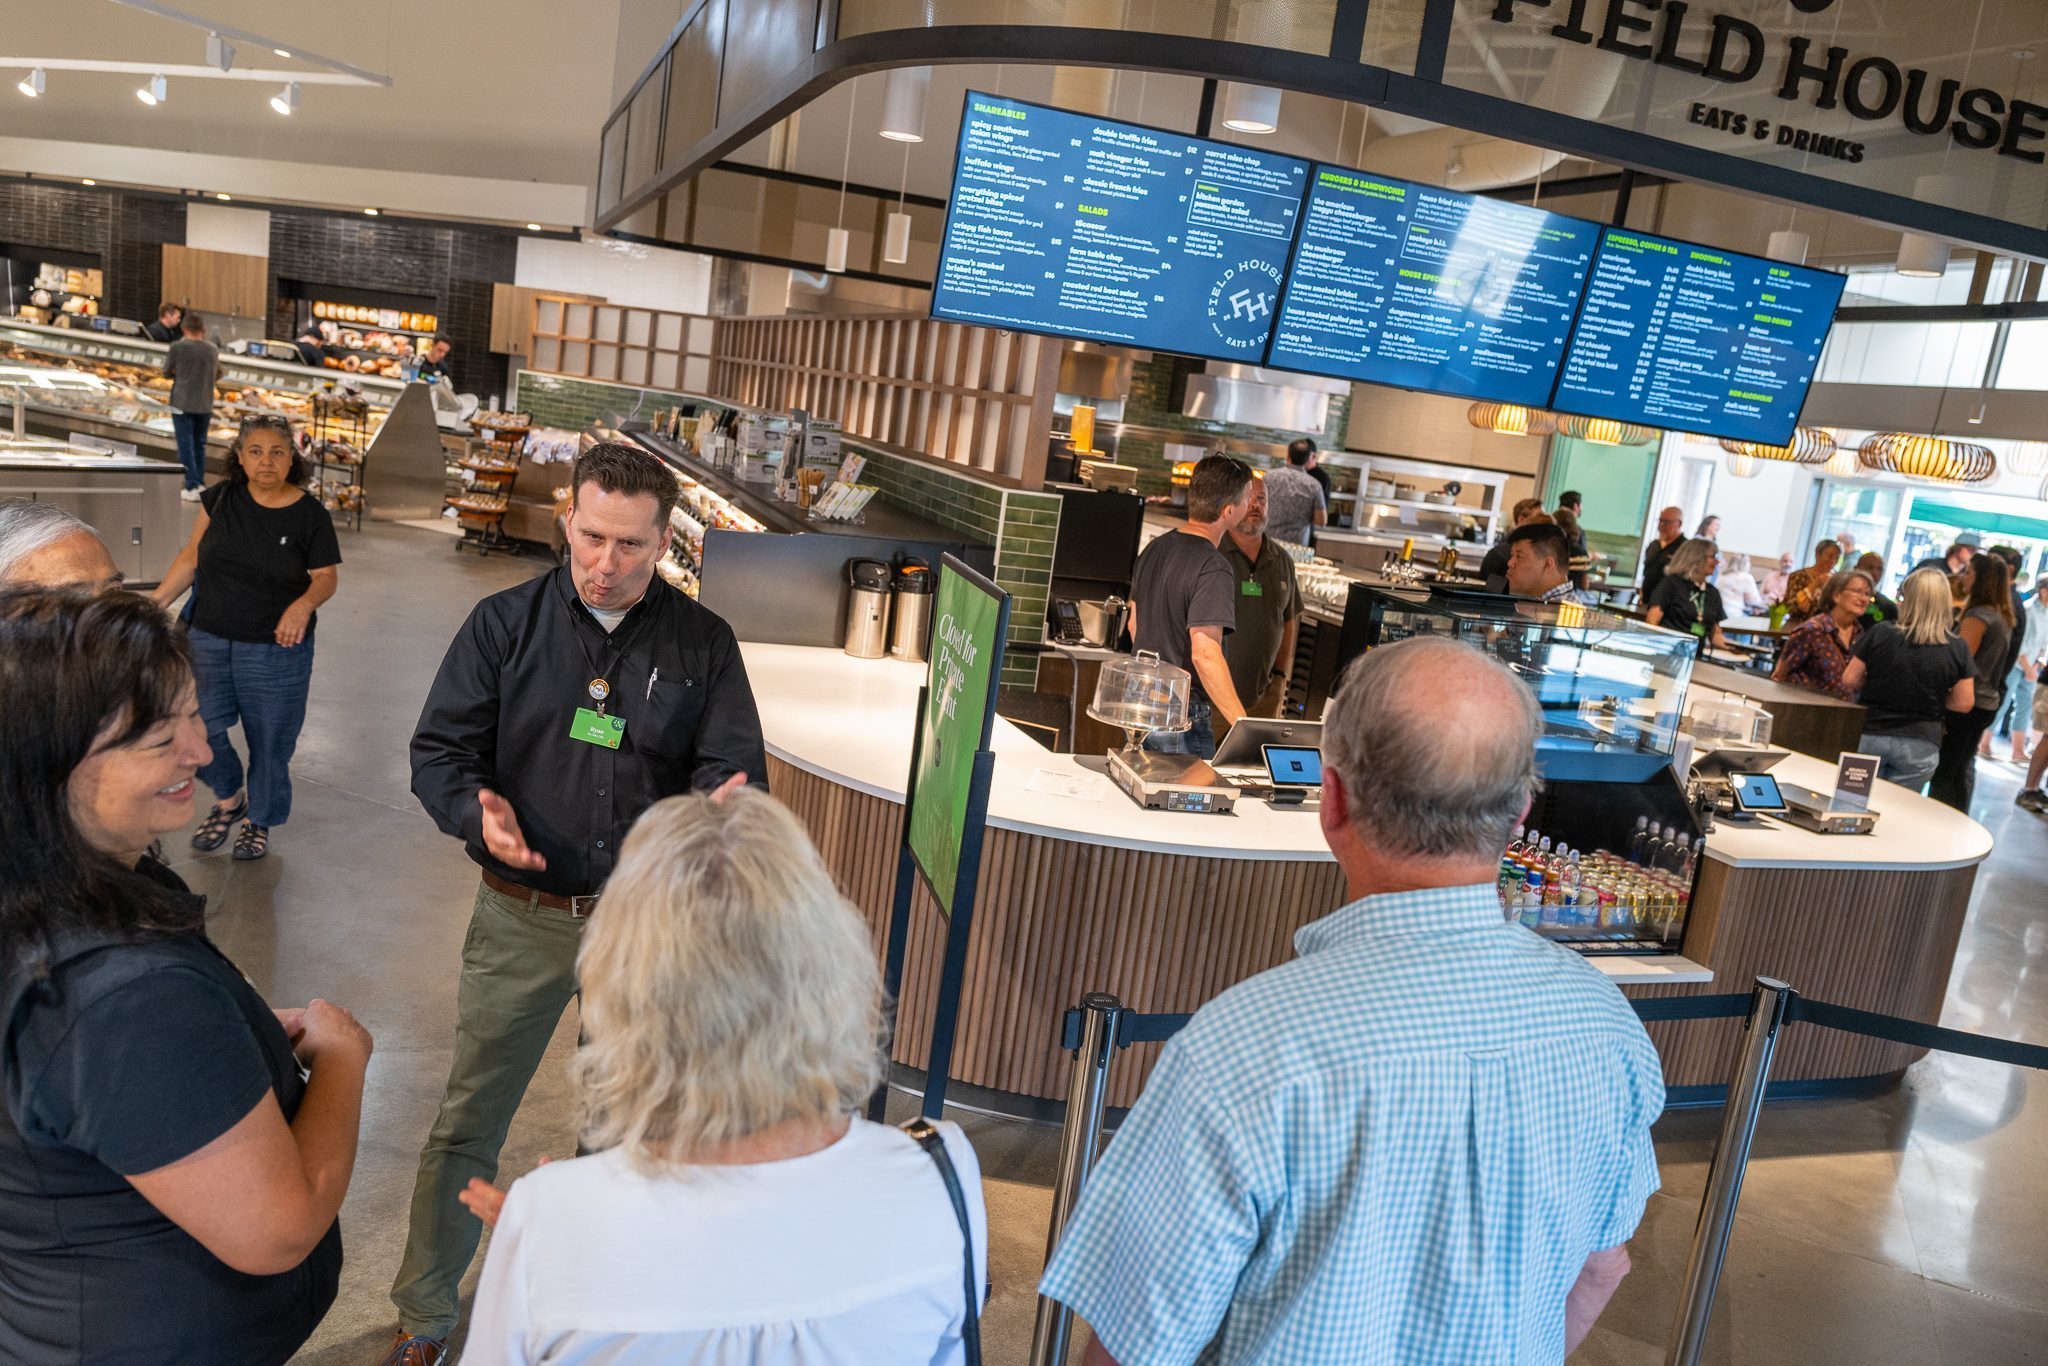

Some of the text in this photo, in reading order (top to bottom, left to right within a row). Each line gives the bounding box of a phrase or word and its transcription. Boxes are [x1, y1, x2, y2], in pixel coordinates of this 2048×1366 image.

[1778, 37, 2048, 164] HOUSE
[975, 104, 1026, 120] SHAREABLES
[970, 129, 1013, 143] asian wings
[971, 120, 1029, 137] spicy southeast
[1093, 127, 1157, 146] double truffle fries
[1690, 103, 1865, 164] EATS & DRINKS
[965, 157, 1014, 173] buffalo wings
[1106, 153, 1133, 164] vinegar
[1134, 157, 1149, 167] fries
[1206, 151, 1260, 167] carrot miso chop
[960, 186, 1024, 202] everything spiced
[1084, 178, 1148, 195] classic french fries
[958, 194, 1003, 207] pretzel bites
[1078, 205, 1108, 216] SALADS
[953, 222, 1013, 237] crispy fish tacos
[1070, 247, 1123, 263] farm table chop
[946, 263, 987, 276] brisket tots
[947, 257, 1005, 271] mama's smoked
[1063, 282, 1090, 290] roasted
[1103, 287, 1119, 295] beet
[1119, 290, 1139, 298] salad
[1208, 269, 1234, 316] FIELD
[1238, 259, 1283, 285] HOUSE
[1226, 336, 1247, 348] EATS
[1280, 333, 1312, 343] crispy fish
[1382, 331, 1394, 339] fish
[1399, 335, 1415, 343] chips
[962, 633, 977, 667] for
[935, 676, 957, 720] Ent
